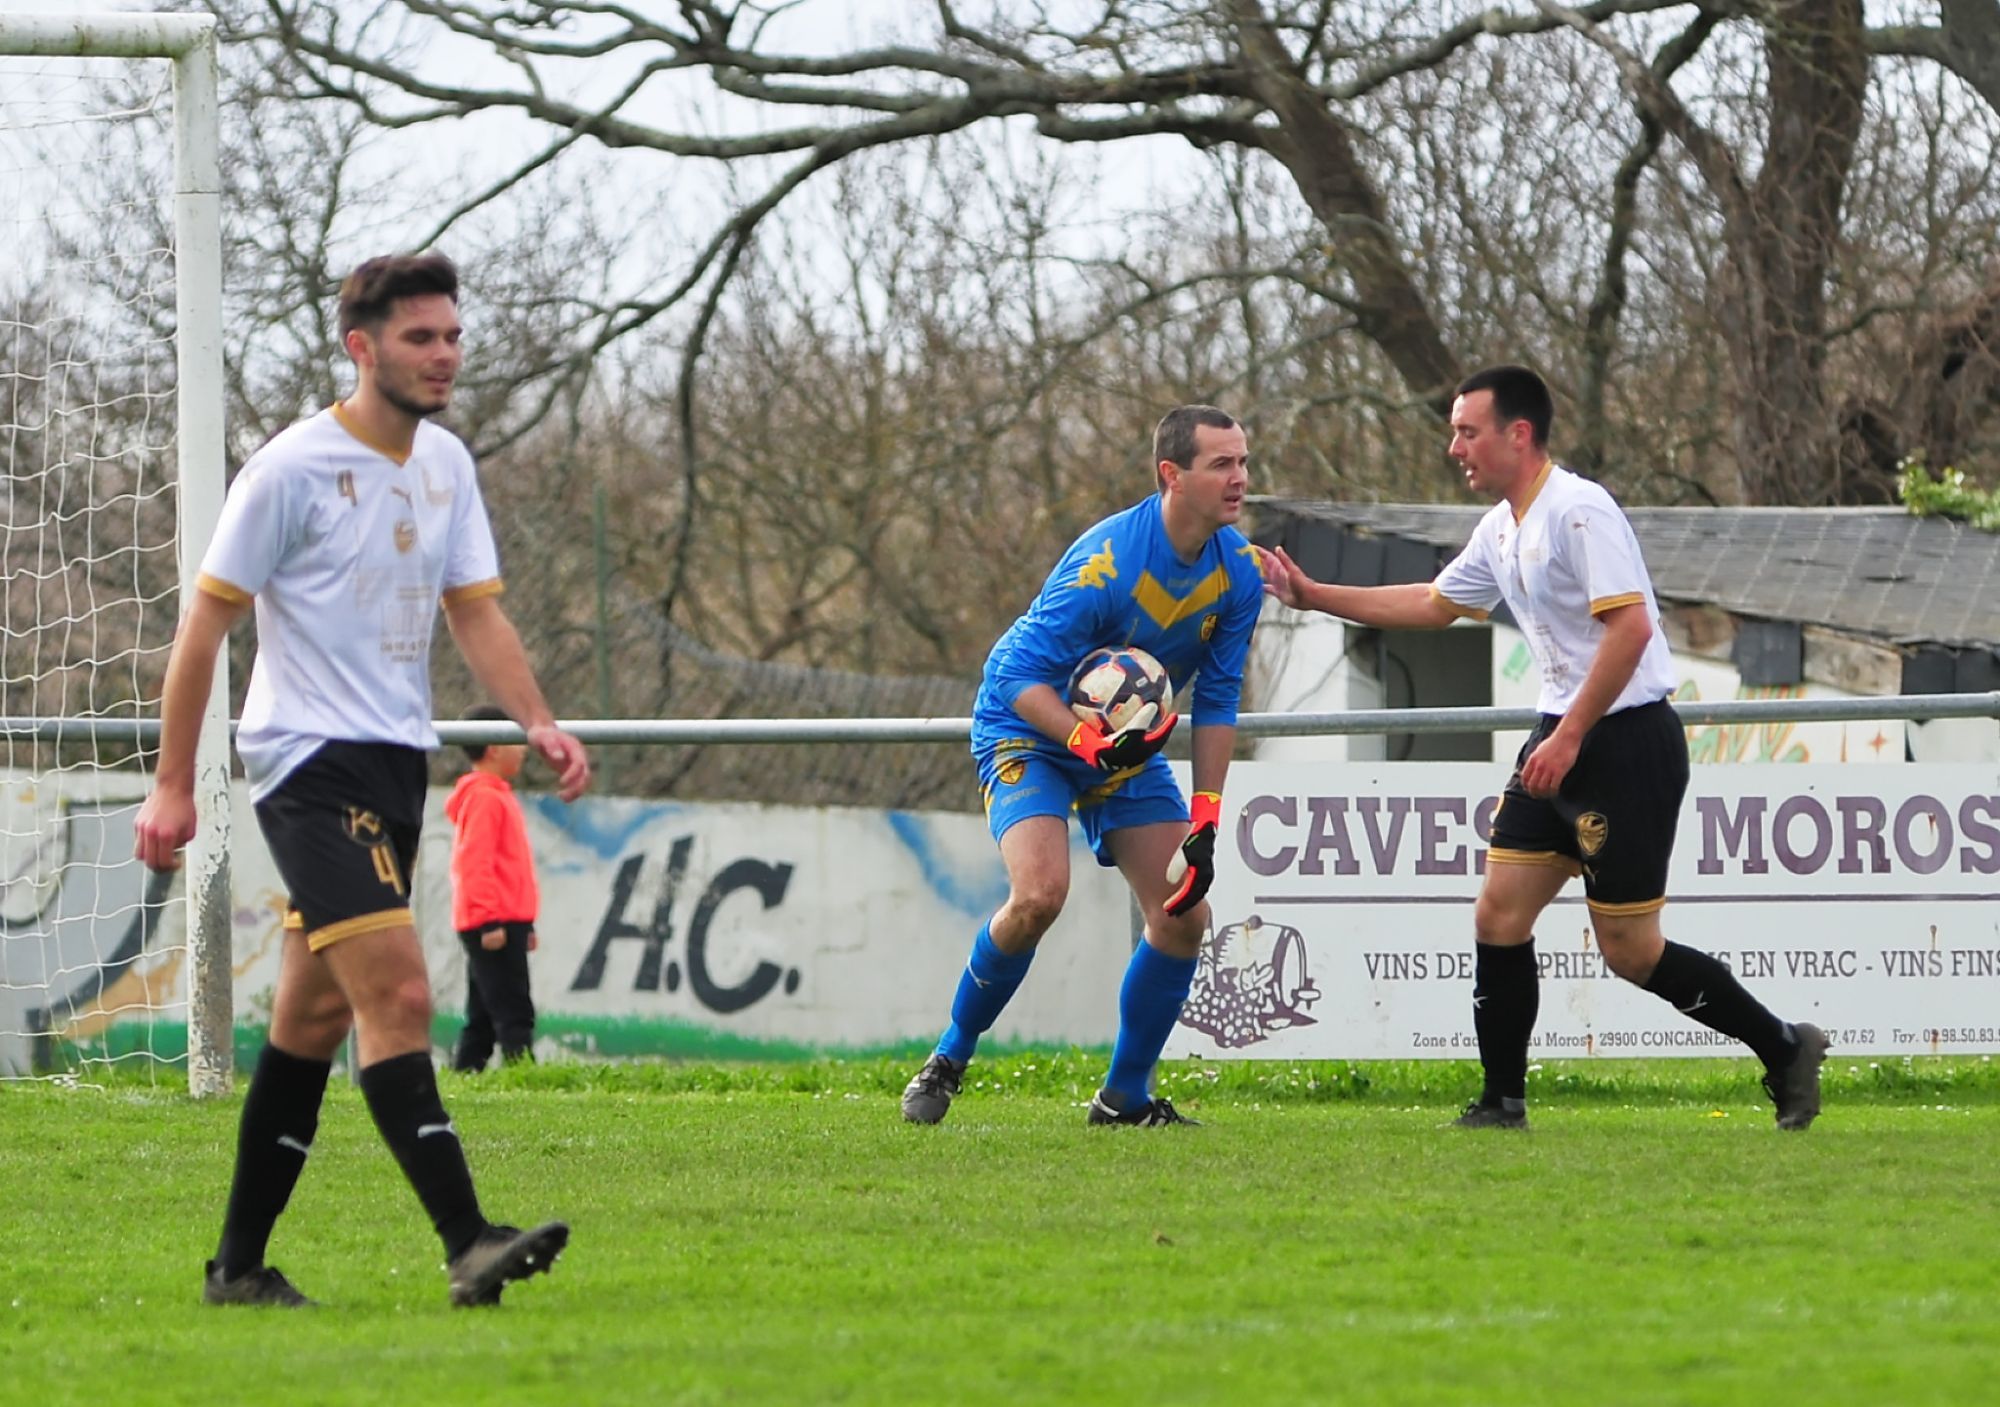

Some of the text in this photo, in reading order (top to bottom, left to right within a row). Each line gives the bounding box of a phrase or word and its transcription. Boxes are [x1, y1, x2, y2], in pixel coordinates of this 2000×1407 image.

[1696, 795, 2000, 875] MOROS
[371, 843, 404, 896] 4
[1363, 953, 1428, 980] VINS
[1436, 953, 1473, 980] DE
[1741, 951, 1776, 977] EN
[1784, 951, 1857, 977] VRAC
[1881, 950, 1943, 977] VINS
[1950, 950, 2000, 977] FIN
[1413, 1032, 1447, 1048] Zone
[1545, 1032, 1586, 1047] Moros
